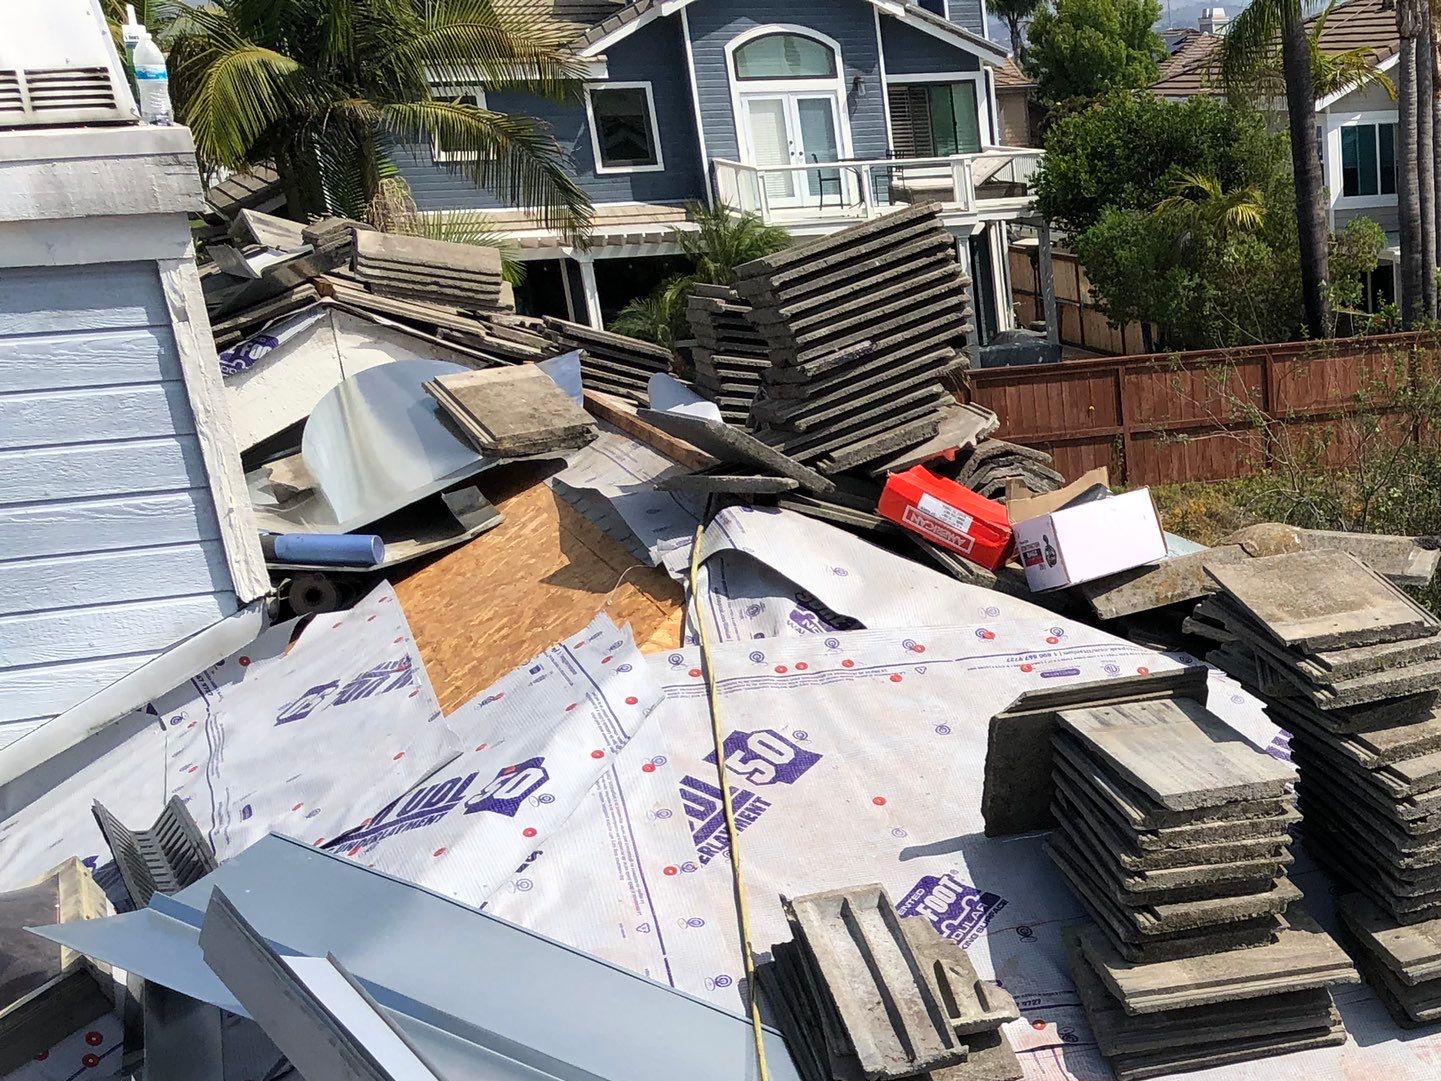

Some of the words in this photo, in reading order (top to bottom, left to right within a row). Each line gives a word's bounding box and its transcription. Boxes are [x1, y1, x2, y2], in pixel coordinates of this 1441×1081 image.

[910, 510, 967, 549] AMERICAN
[724, 731, 796, 786] 50
[952, 903, 988, 942] DULAR
